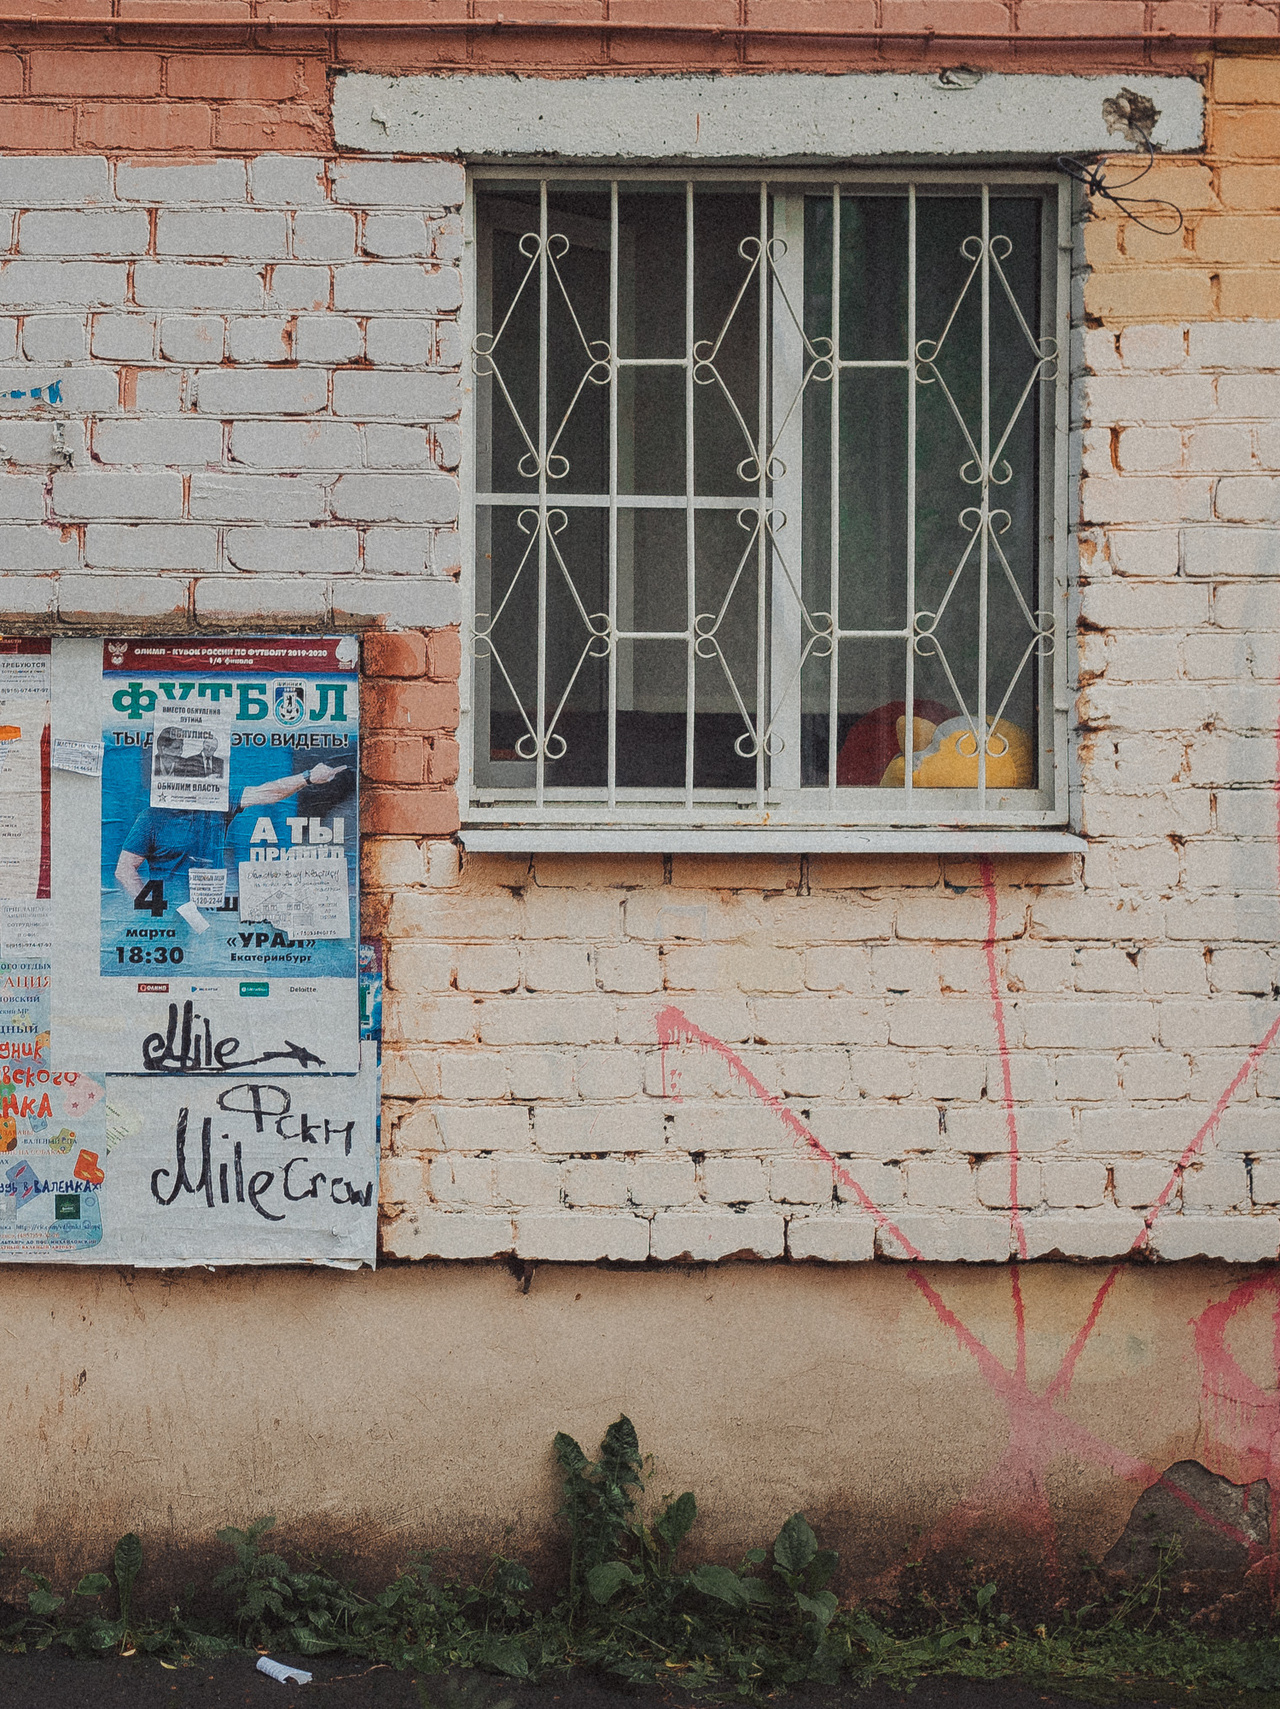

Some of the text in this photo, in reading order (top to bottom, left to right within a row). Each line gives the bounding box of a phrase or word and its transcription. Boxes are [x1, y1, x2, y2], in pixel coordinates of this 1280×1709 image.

[113, 732, 140, 746] ТЫ
[232, 733, 348, 748] ЭТО ВИДЕТЬ!
[157, 782, 220, 792] ОБНУЛИМ ВЛАСТЬ
[250, 816, 345, 844] А ТЫ
[134, 879, 168, 918] 4
[126, 928, 176, 938] марта
[116, 946, 184, 964] 18:30
[230, 953, 312, 963] Екатеринбург
